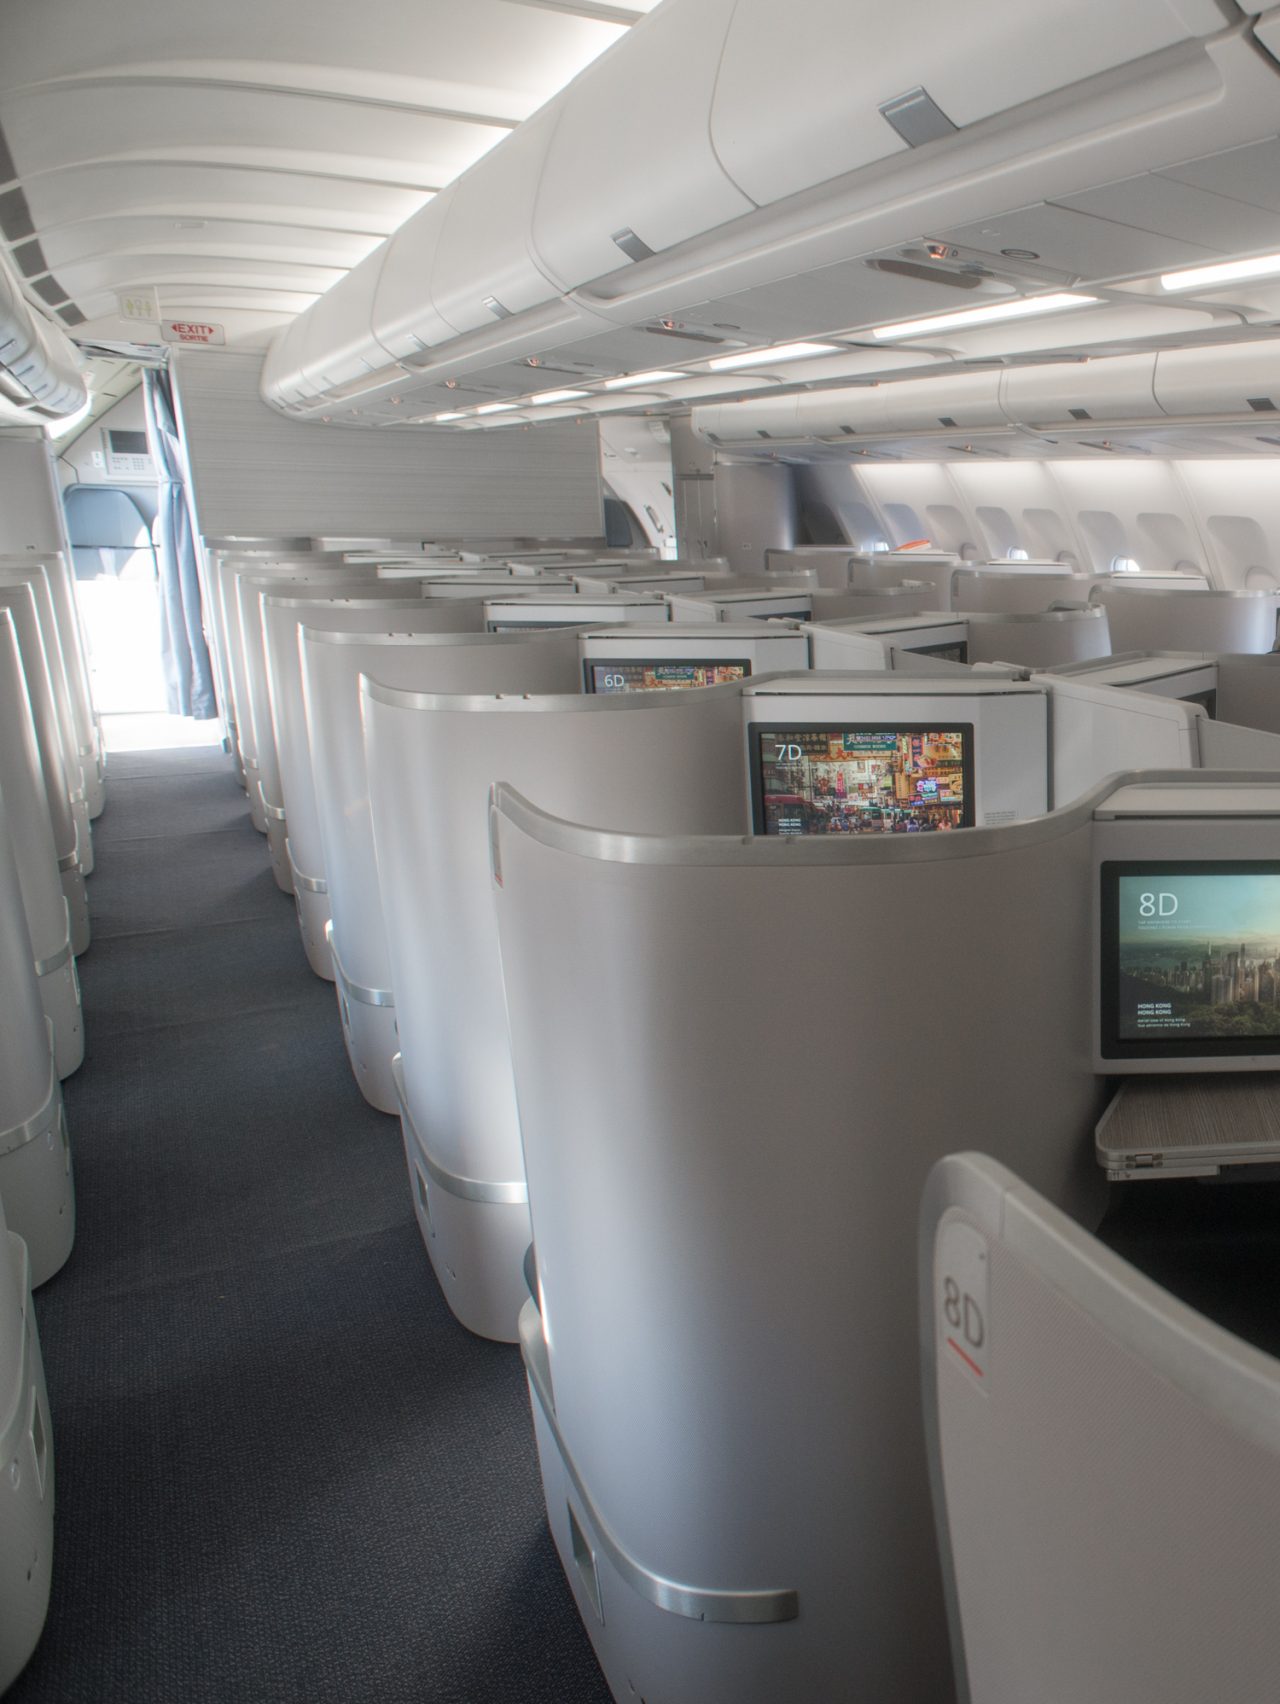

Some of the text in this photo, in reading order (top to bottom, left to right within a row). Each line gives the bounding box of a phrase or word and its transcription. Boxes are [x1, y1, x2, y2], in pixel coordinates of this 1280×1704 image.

[177, 323, 207, 334] EXIT
[179, 334, 209, 342] SORTIE
[604, 674, 625, 687] 6D
[775, 744, 802, 761] 7D
[1140, 892, 1178, 916] 8D
[943, 1275, 985, 1348] 8D
